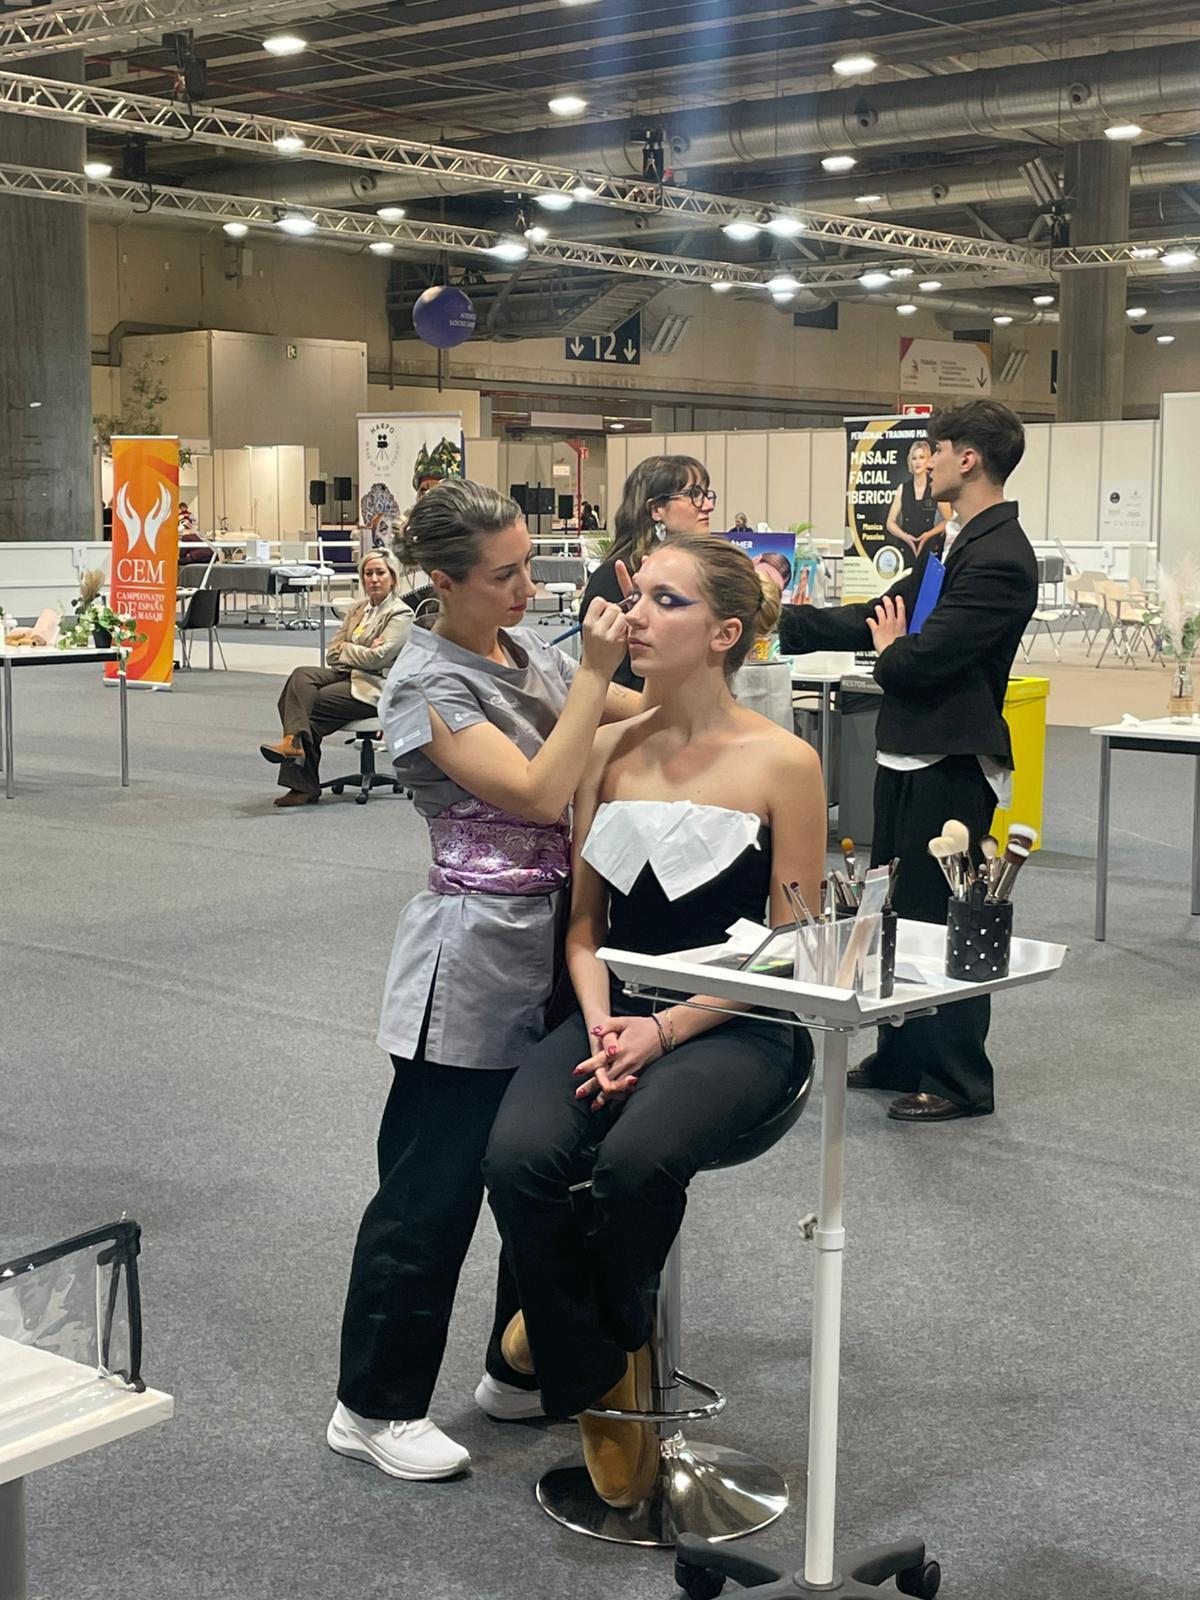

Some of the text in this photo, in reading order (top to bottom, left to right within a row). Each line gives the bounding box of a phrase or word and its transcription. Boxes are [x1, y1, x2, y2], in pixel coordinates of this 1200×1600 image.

[591, 332, 617, 360] 12
[370, 422, 395, 434] HARPO
[885, 429, 915, 439] TRAINING
[850, 450, 898, 465] MASAJE
[850, 470, 890, 484] FACIAL
[117, 558, 166, 584] CEM
[116, 592, 164, 601] CAMPEONATO
[116, 600, 136, 620] DE
